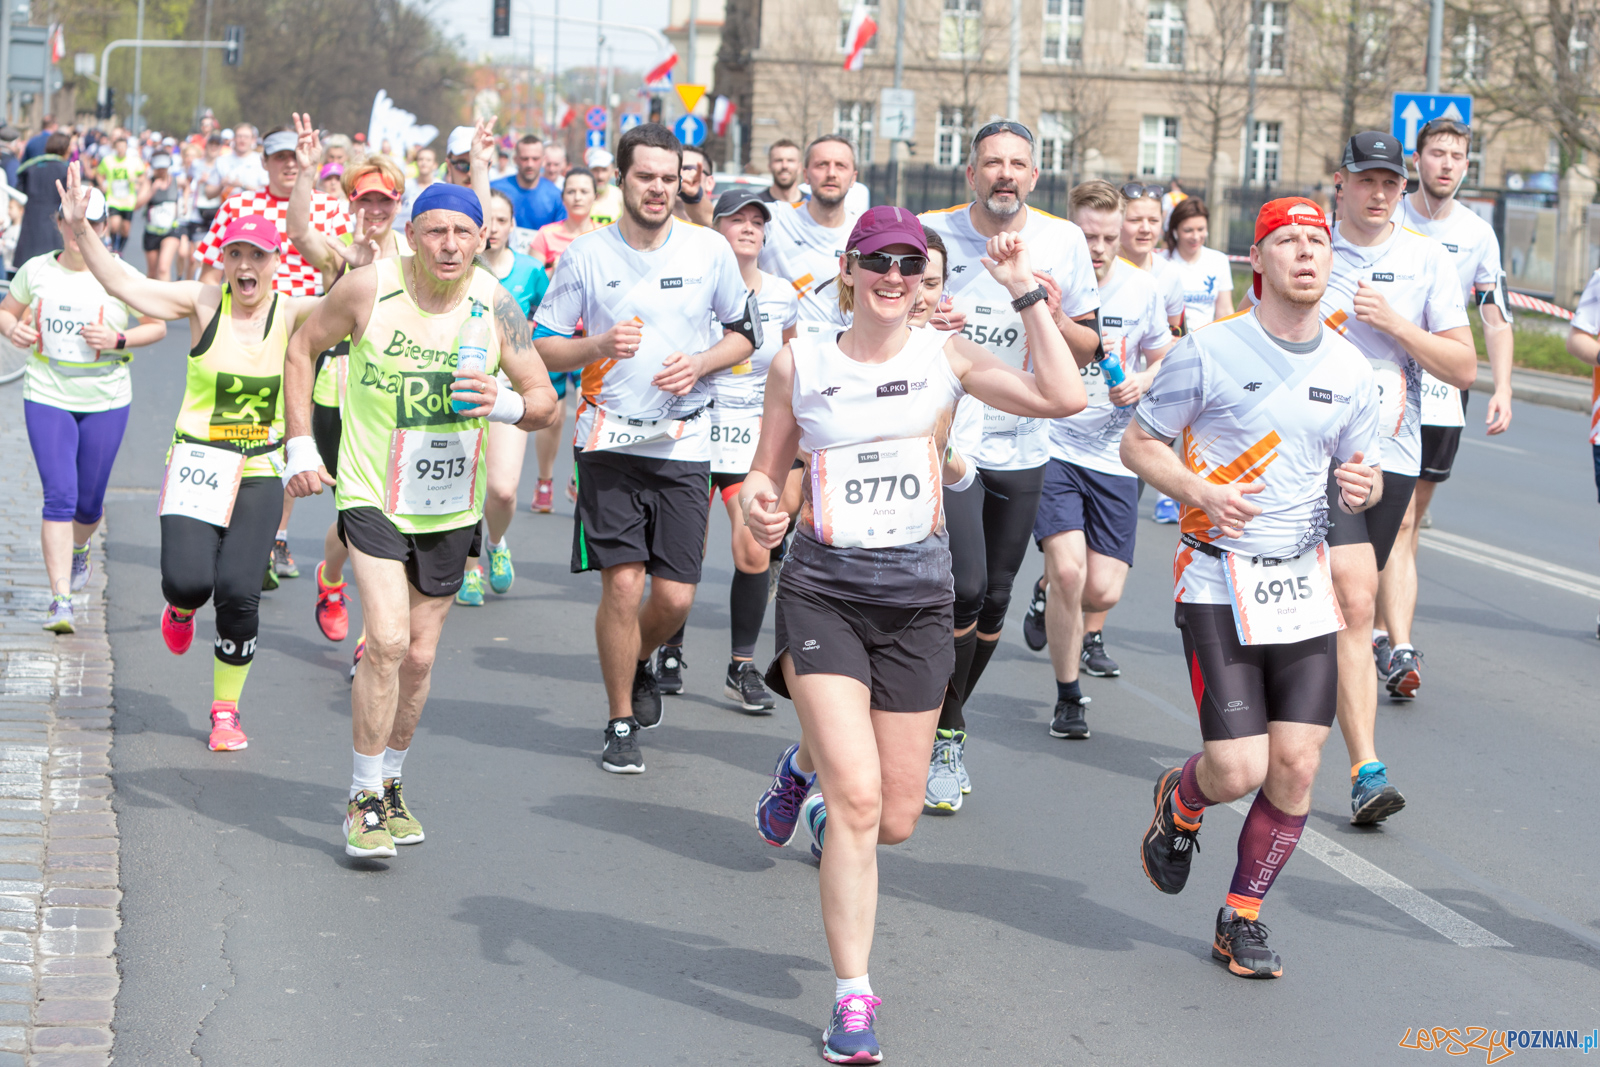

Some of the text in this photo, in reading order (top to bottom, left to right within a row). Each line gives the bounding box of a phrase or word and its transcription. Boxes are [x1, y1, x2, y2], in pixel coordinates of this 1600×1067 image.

[952, 265, 967, 273] 4F
[45, 318, 91, 335] 1092
[961, 324, 1018, 347] 5549
[821, 386, 842, 396] 4F
[1243, 382, 1263, 392] 4F
[982, 413, 1006, 421] lberta
[224, 426, 266, 439] night
[711, 425, 751, 444] 8126
[416, 457, 466, 480] 9513
[179, 466, 219, 490] 904
[427, 483, 453, 491] Leonard
[845, 474, 920, 504] 8770
[873, 508, 896, 516] Anna
[1254, 576, 1313, 604] 6915
[1248, 829, 1298, 893] Kalenji
